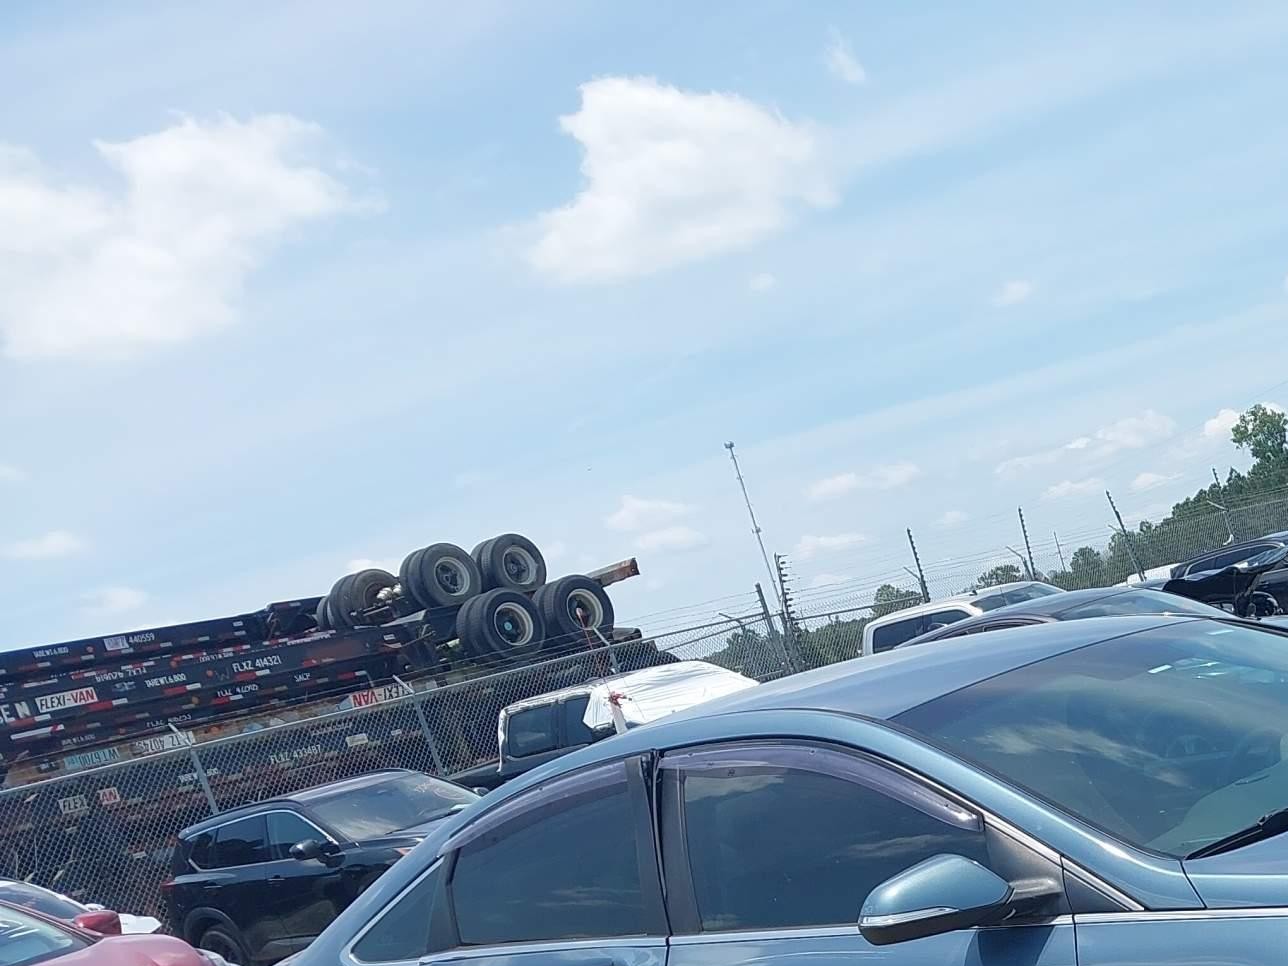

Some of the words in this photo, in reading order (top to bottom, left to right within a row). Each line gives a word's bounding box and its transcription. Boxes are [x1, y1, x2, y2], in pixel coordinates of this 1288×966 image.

[232, 661, 255, 673] FLXZ
[255, 655, 282, 668] 414321
[40, 689, 95, 713] FLEXI-VAN
